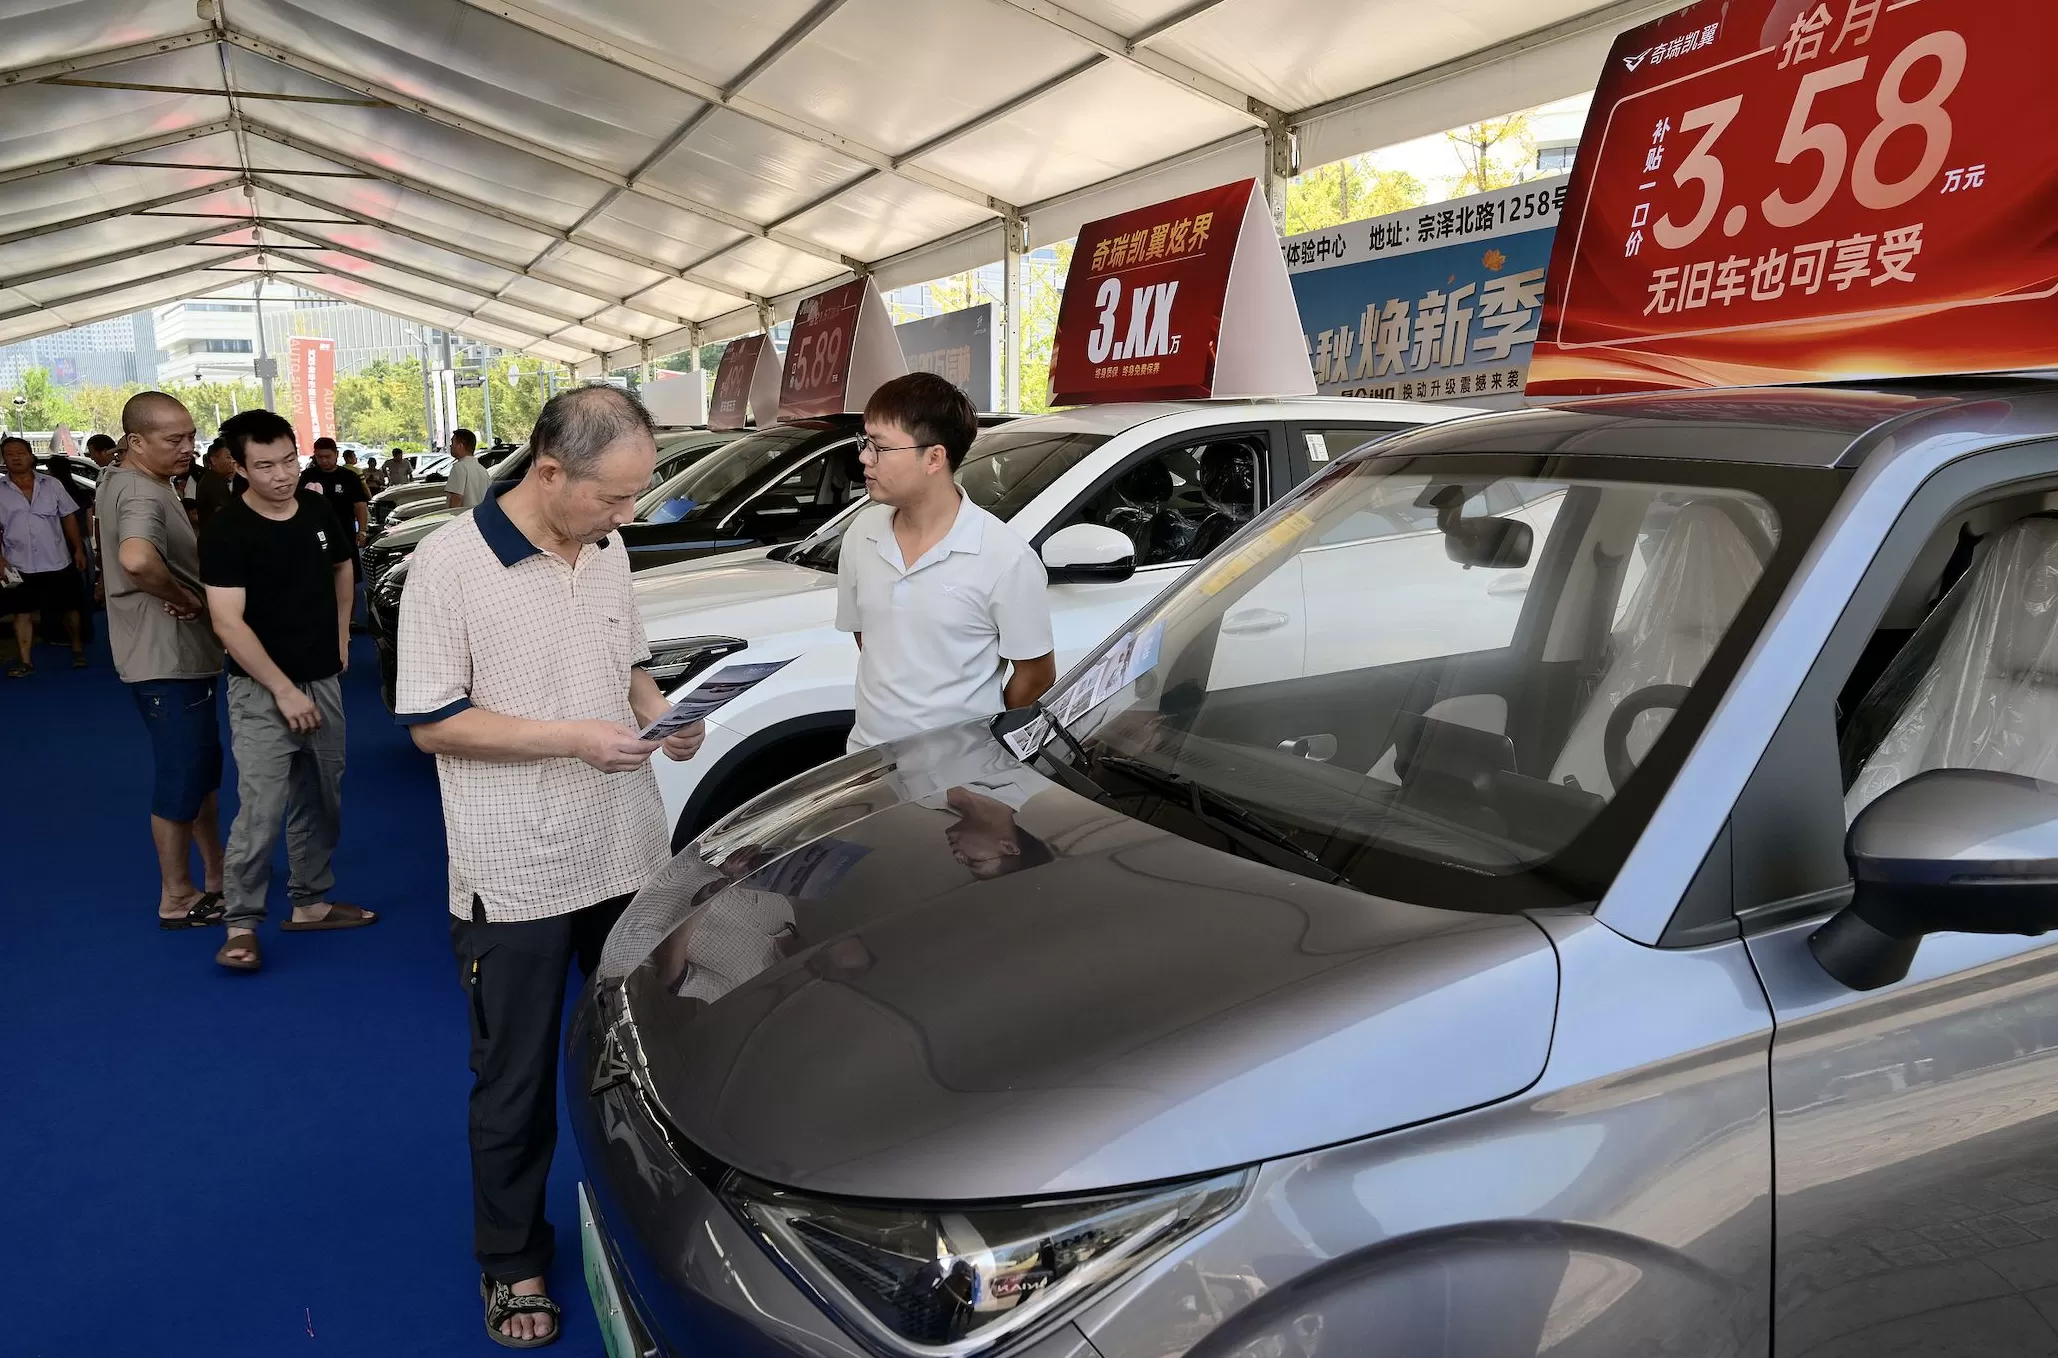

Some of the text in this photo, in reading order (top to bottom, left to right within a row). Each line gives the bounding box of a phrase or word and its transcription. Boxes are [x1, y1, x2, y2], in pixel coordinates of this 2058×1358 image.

[1650, 22, 1718, 65] 奇瑞凯翼
[1653, 30, 1985, 250] 3.58 万元
[1625, 117, 1670, 258] 补贴一口价
[1091, 212, 1214, 271] 奇瑞凯翼炫界
[1281, 233, 1346, 267] 体验中心
[1643, 223, 1923, 316] 无旧车也可享受
[1088, 278, 1181, 364] 3.XX 万
[1303, 268, 1545, 386] 秋焕新季
[794, 327, 842, 390] 5.89
[1403, 370, 1519, 399] 换动升级震撼来袭
[324, 388, 334, 420] AUTO
